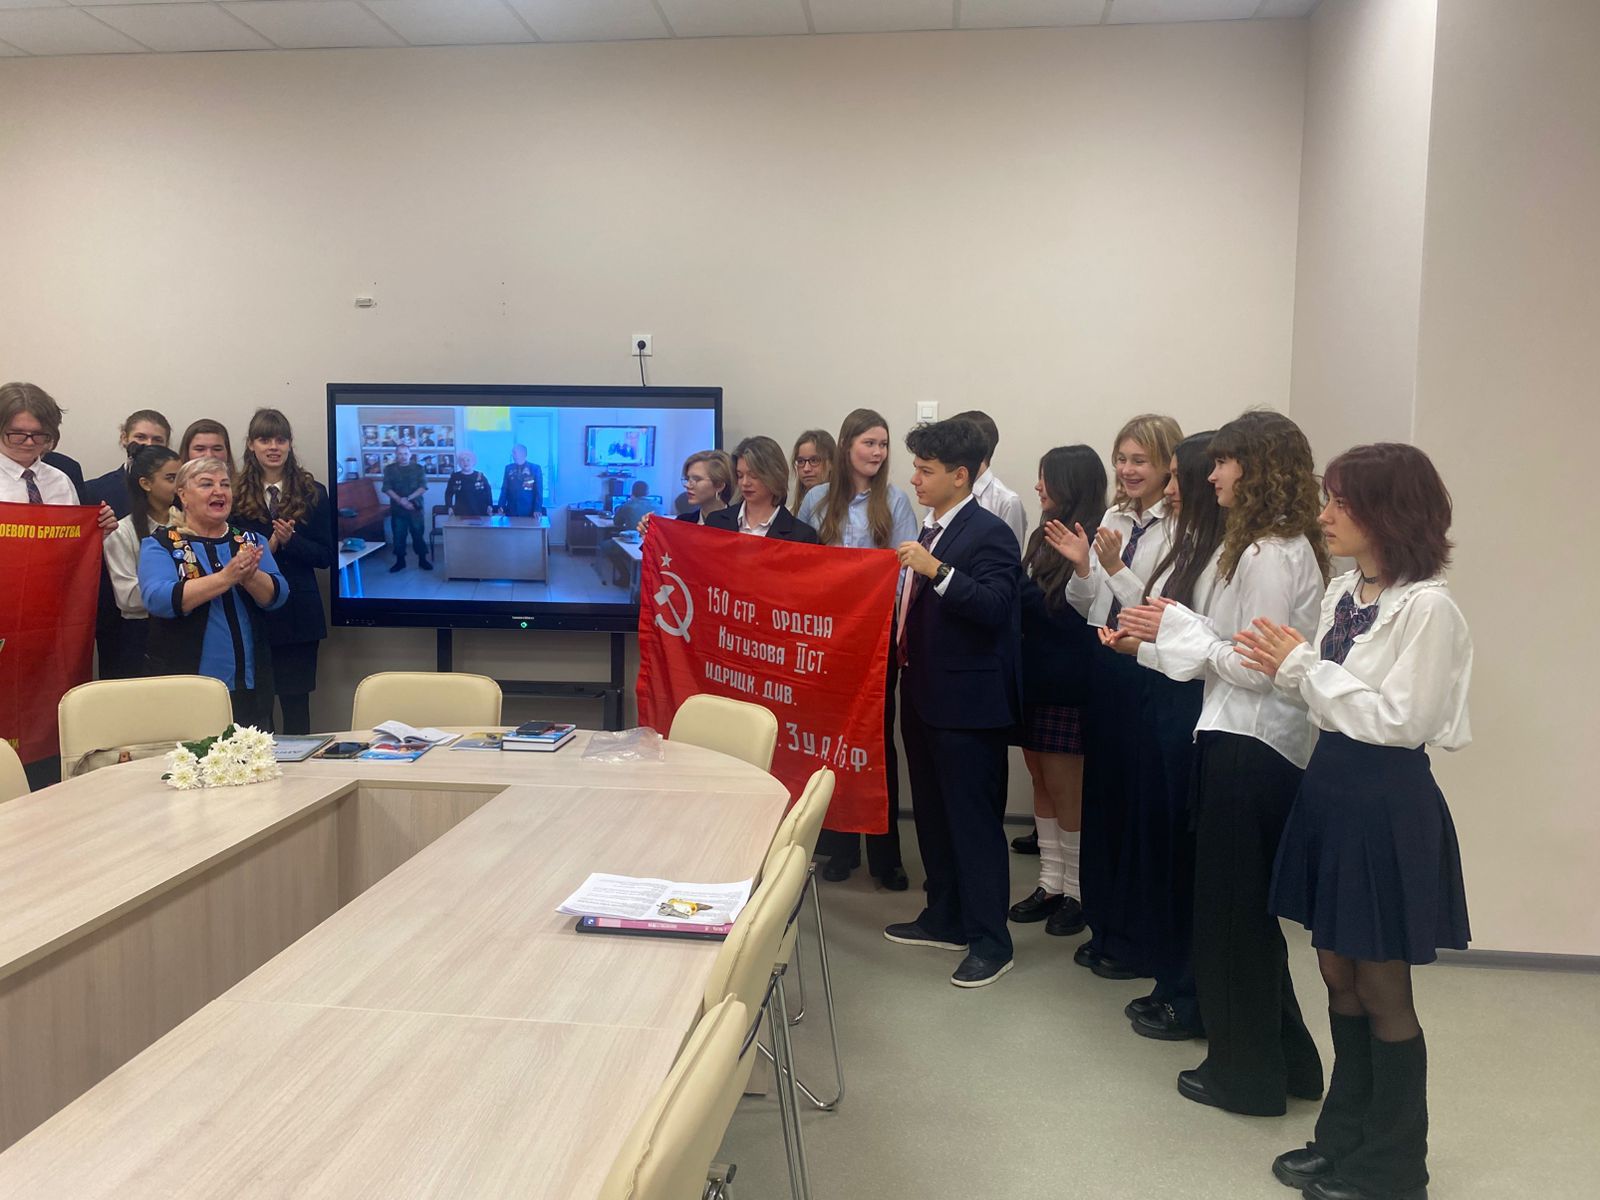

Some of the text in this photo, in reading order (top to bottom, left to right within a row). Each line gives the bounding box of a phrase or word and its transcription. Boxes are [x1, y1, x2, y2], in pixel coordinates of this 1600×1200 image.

[37, 525, 81, 539] БРАТСТВА
[707, 585, 729, 616] 150
[772, 609, 833, 638] ОРДЕНА
